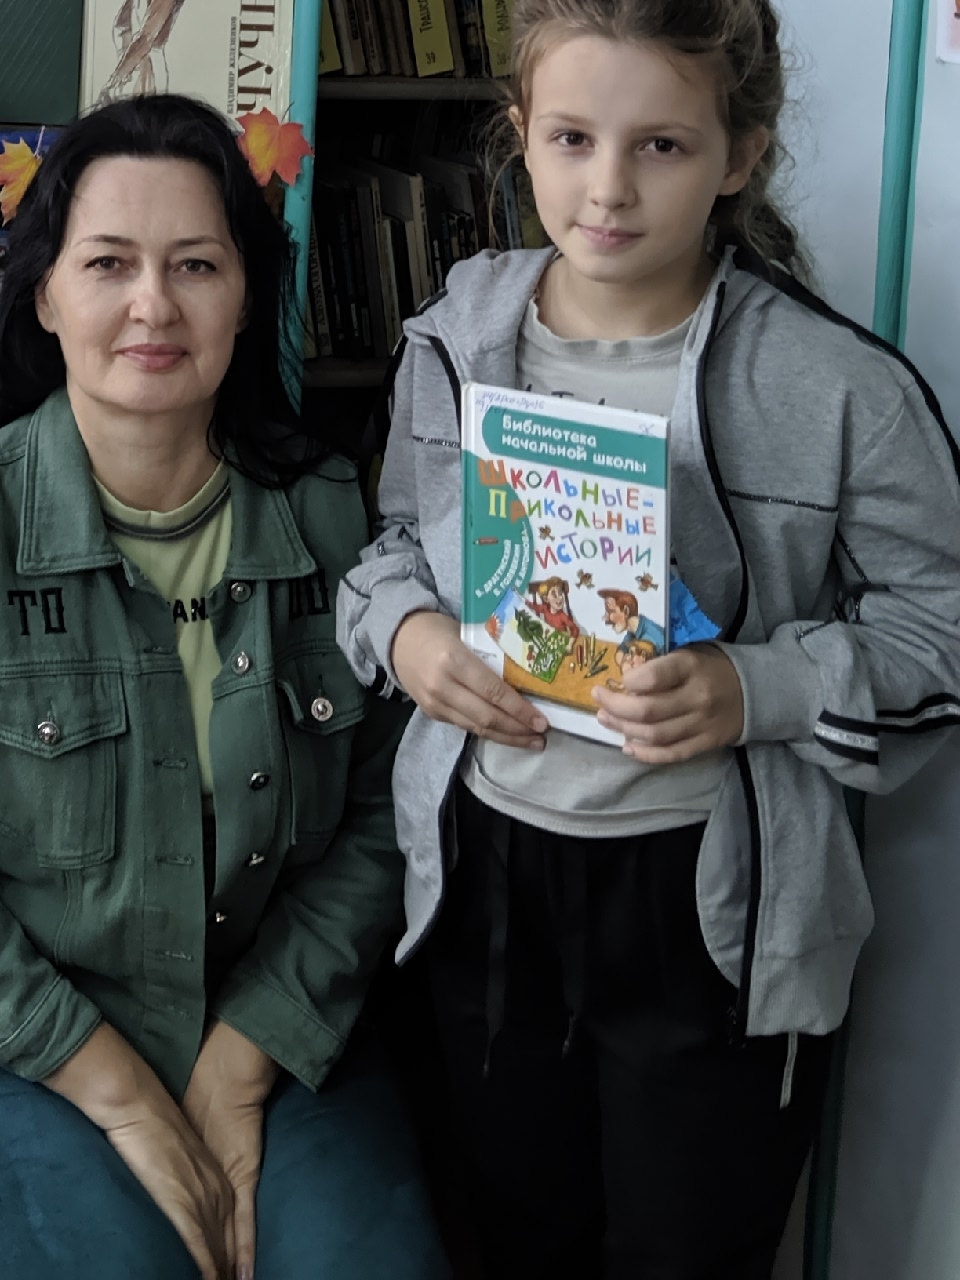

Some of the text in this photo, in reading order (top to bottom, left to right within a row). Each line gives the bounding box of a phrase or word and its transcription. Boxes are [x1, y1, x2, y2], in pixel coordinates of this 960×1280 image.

[501, 414, 598, 448] Библиотека
[501, 433, 647, 474] начальной школы
[488, 488, 657, 537] ПРИКОЛЬНЫЕ
[534, 531, 652, 571] ИСТОРИИ
